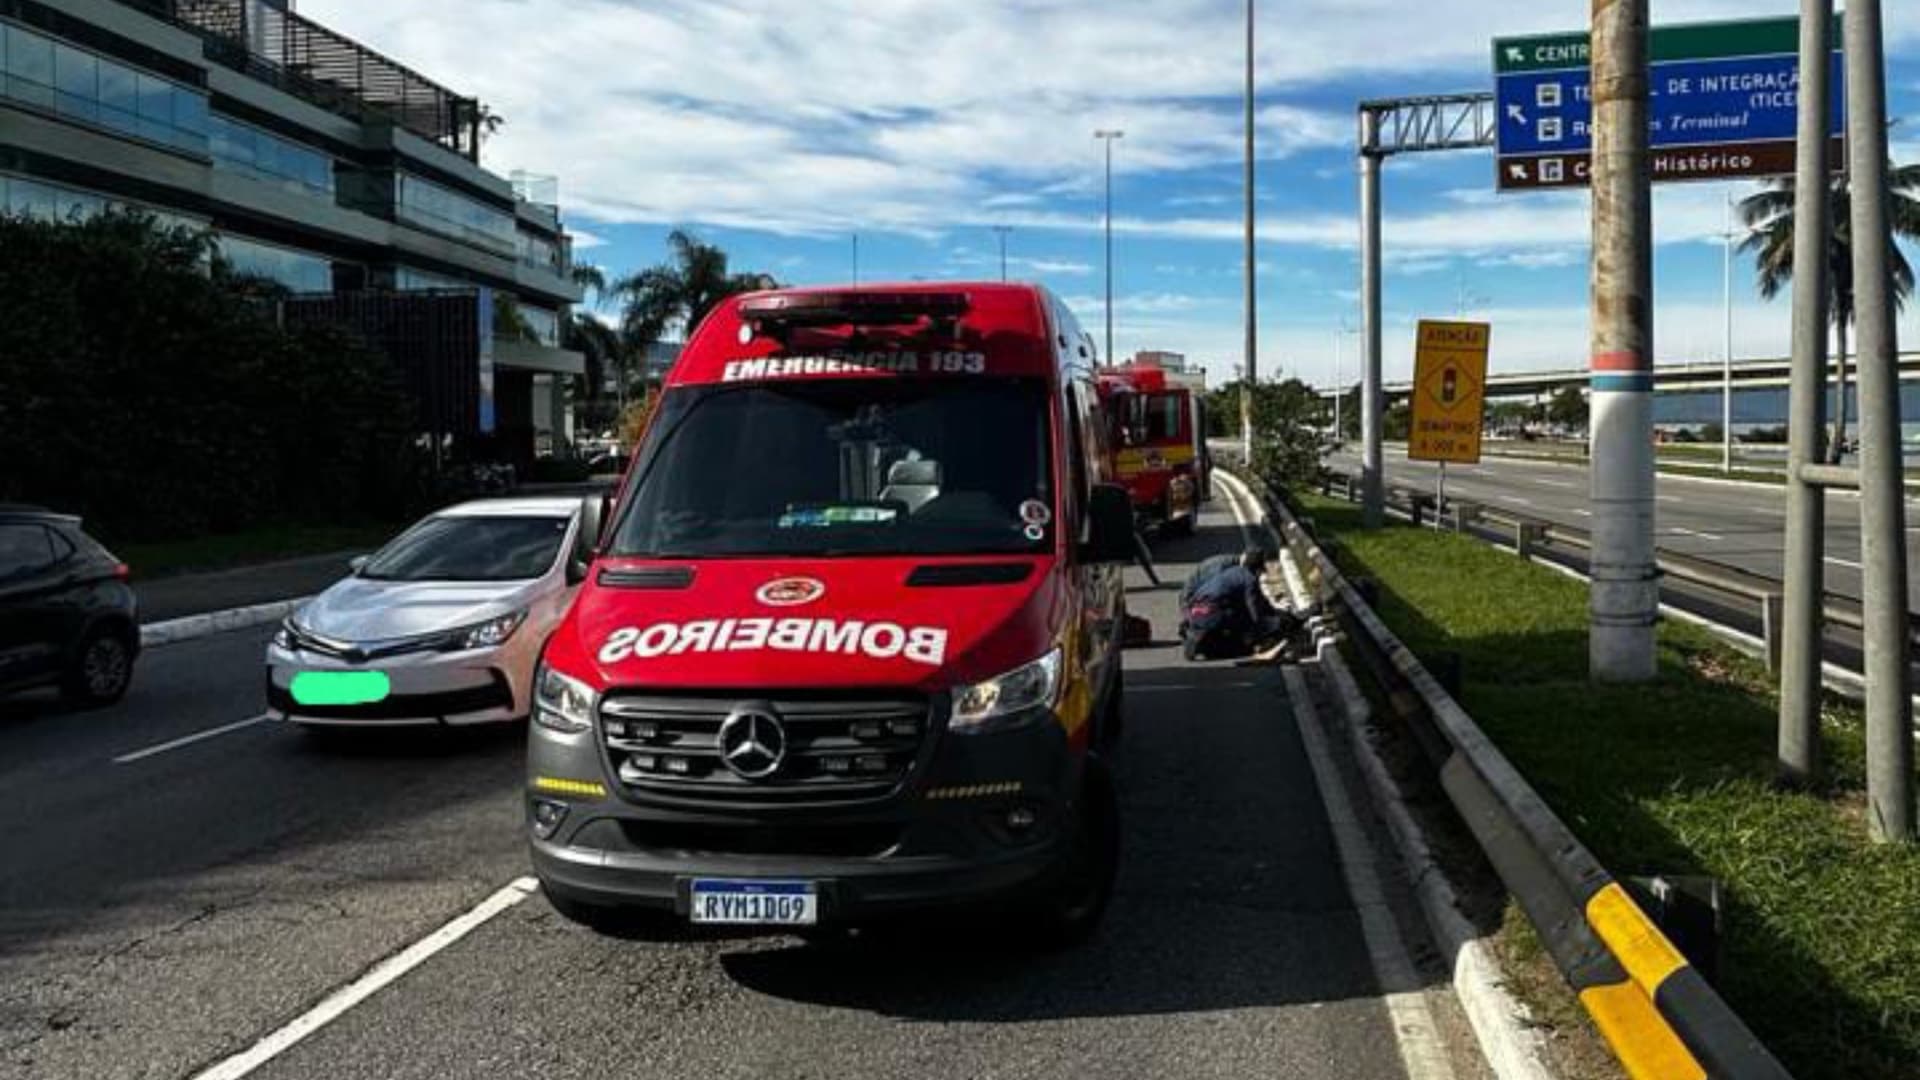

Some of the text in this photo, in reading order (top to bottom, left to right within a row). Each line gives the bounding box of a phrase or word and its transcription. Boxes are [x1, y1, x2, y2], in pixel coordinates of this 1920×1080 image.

[1535, 43, 1592, 62] CENTR
[1668, 66, 1799, 94] DE INTEGRAÇÃ
[1751, 91, 1794, 110] (TICE
[1670, 110, 1750, 130] Terminal
[1654, 154, 1753, 172] Histórico
[927, 351, 985, 373] 193
